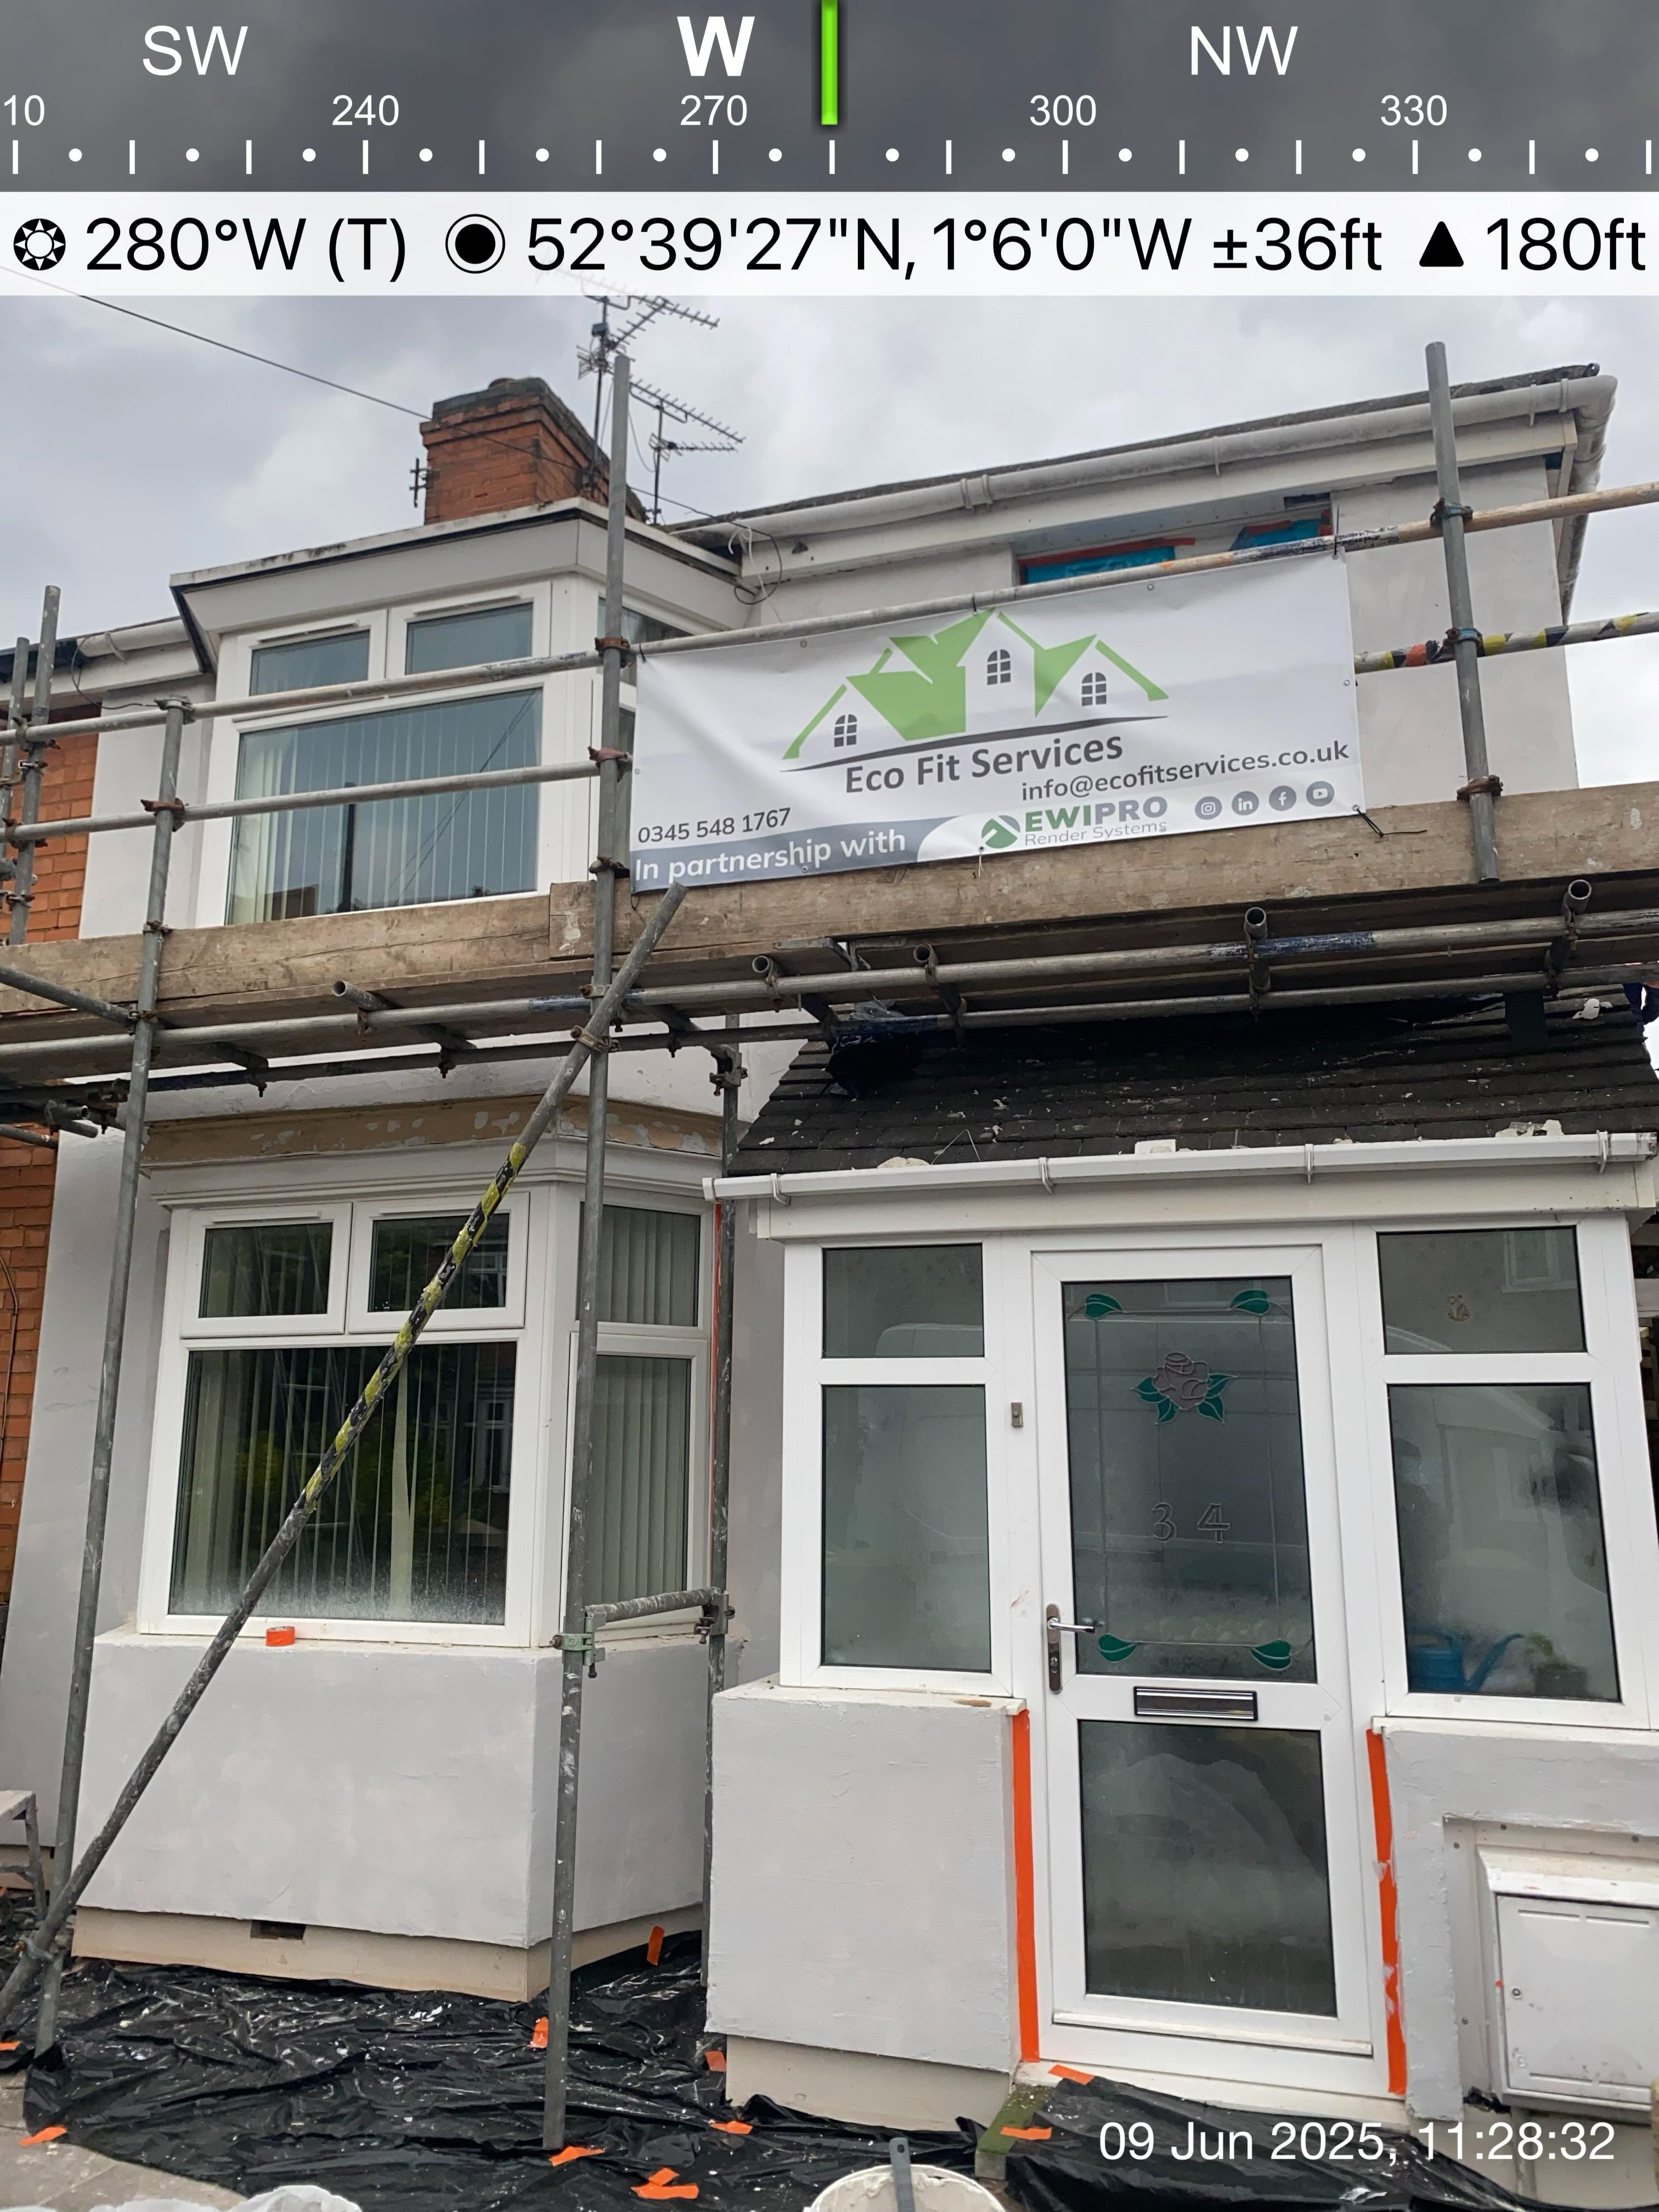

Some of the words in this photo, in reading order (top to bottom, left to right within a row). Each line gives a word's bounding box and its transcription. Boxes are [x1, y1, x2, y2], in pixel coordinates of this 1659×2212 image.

[846, 766, 904, 793] Eco
[917, 754, 960, 785] Fit
[971, 736, 1123, 778] Services
[1022, 740, 1350, 801] info@ecofitservices.co.uk
[638, 823, 690, 843] 0345
[697, 817, 735, 838] 548
[742, 807, 791, 832] 1767
[1025, 796, 1168, 832] EWIPRO
[1025, 830, 1087, 846] Render
[1092, 821, 1167, 839] Systems
[635, 859, 659, 881] In
[668, 839, 831, 884] partnership
[840, 829, 906, 856] with
